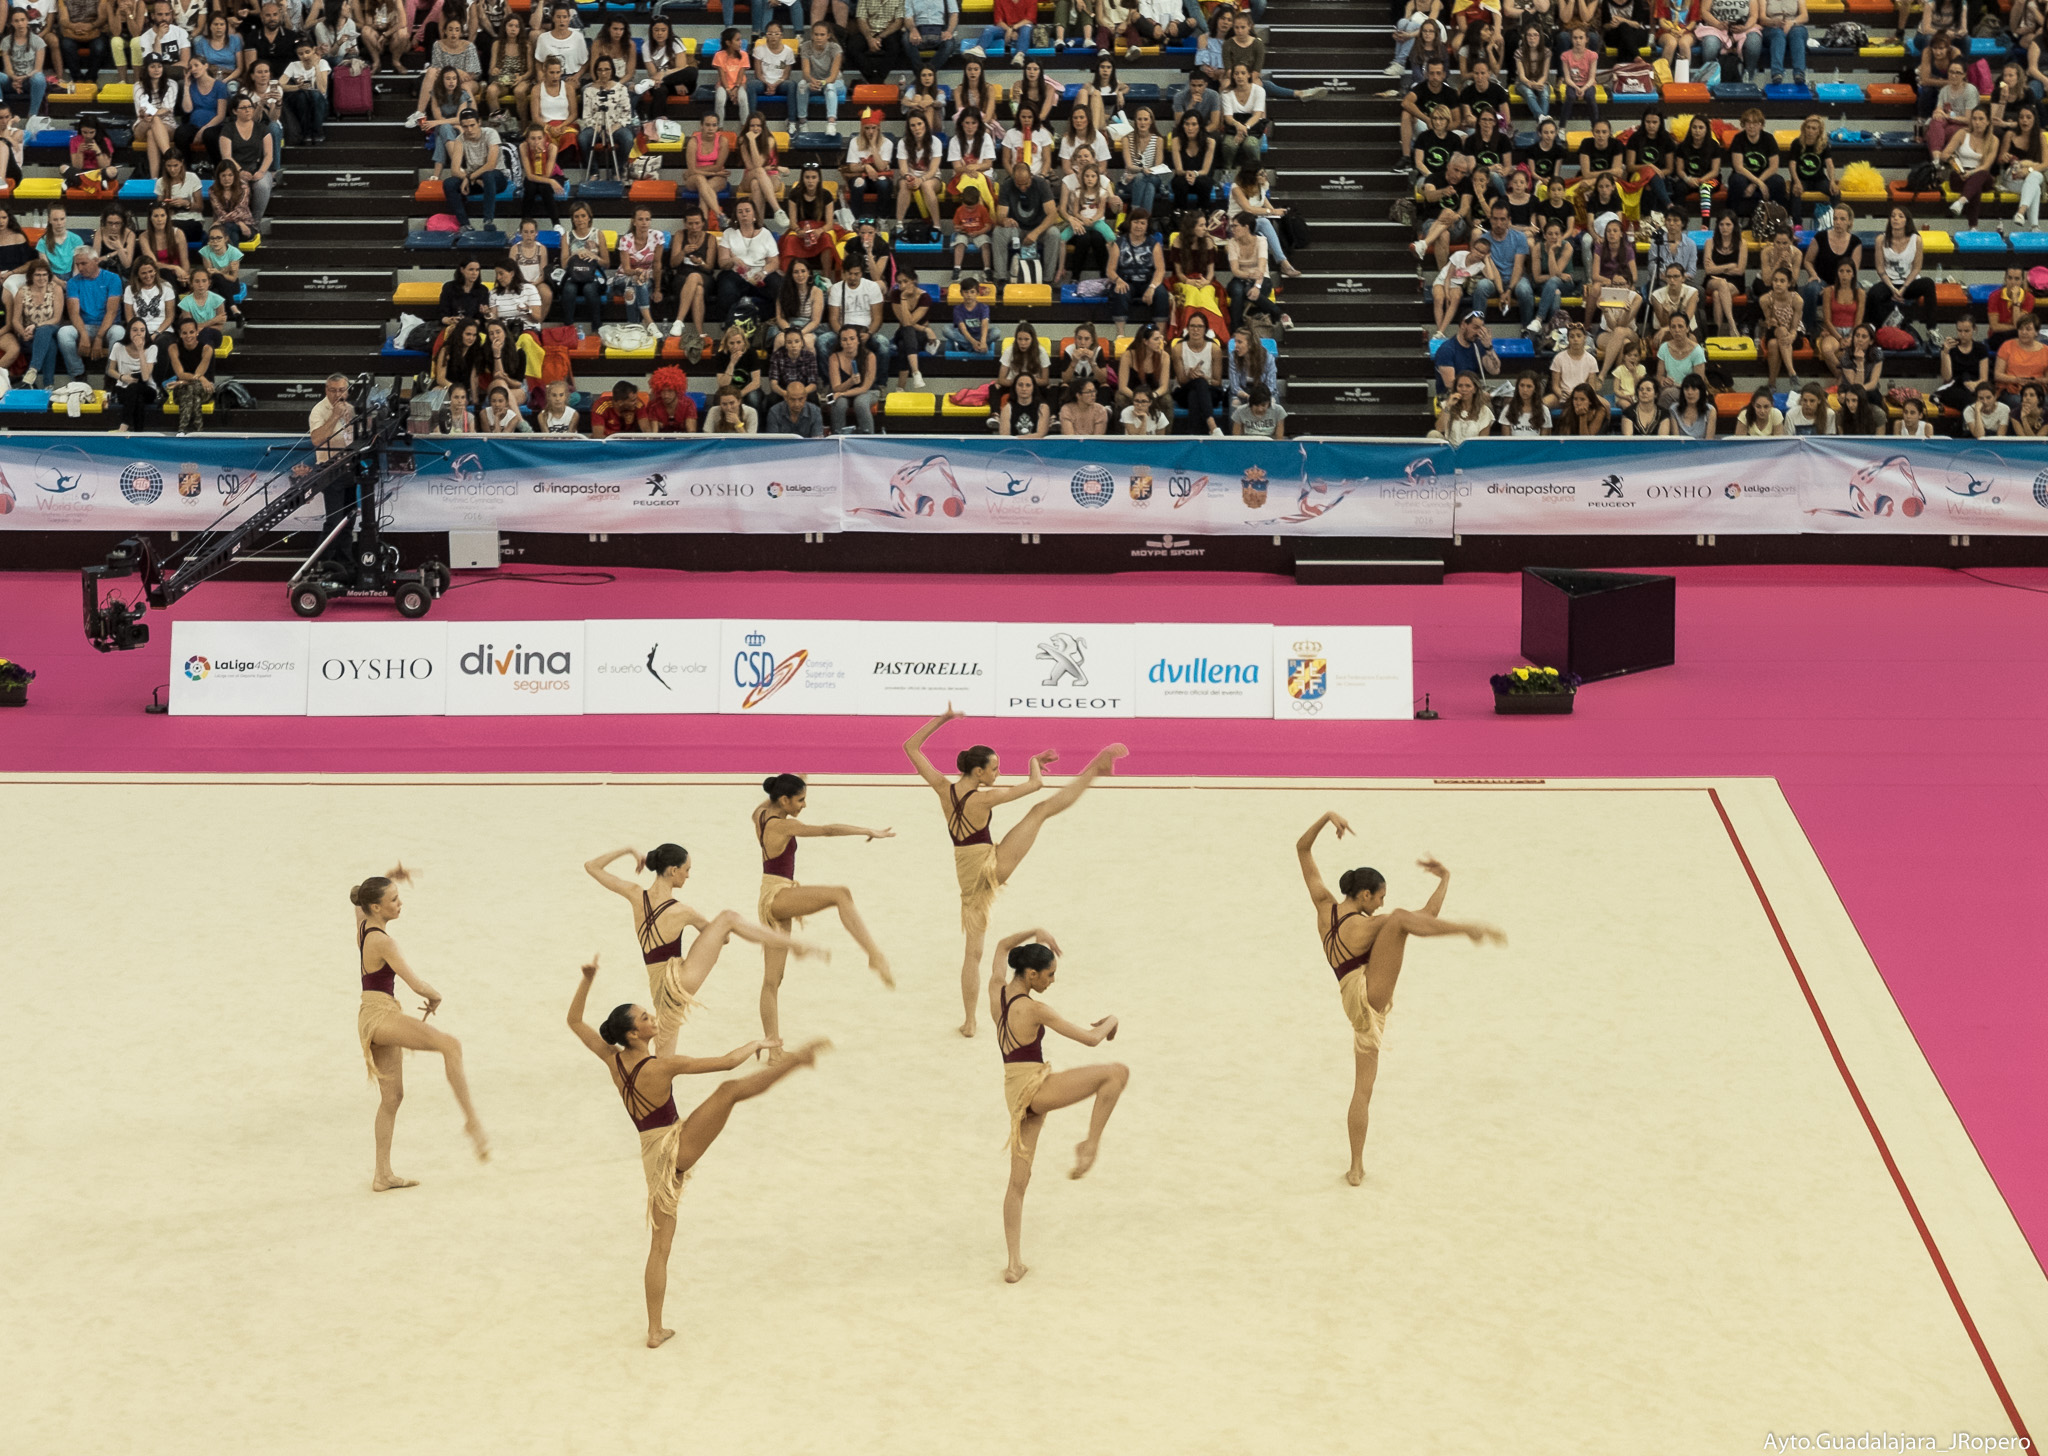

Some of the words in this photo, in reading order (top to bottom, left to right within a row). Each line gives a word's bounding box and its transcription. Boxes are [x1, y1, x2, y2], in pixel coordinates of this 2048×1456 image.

[217, 474, 239, 496] CSD
[427, 481, 518, 497] International
[533, 482, 620, 496] divinapastora
[690, 483, 754, 497] OYSHO
[1168, 476, 1191, 497] CSD
[1487, 482, 1576, 496] divinapastora
[1646, 485, 1712, 499] OYSHO
[1131, 548, 1167, 557] MOYPE
[1170, 548, 1205, 556] SPORT
[214, 659, 295, 672] LaLiga4Sports
[460, 644, 570, 675] divina
[805, 659, 833, 669] Consejo
[322, 658, 433, 681] OYSHO
[597, 663, 608, 673] el
[610, 663, 642, 673] sueño
[662, 663, 678, 673] de
[680, 664, 708, 673] volar
[734, 651, 774, 688] CSD
[805, 670, 836, 680] Superior
[837, 670, 846, 679] de
[1149, 658, 1259, 684] dvillena
[513, 679, 570, 694] seguros
[805, 680, 836, 690] Deportes
[1009, 697, 1121, 709] PEUGEOT
